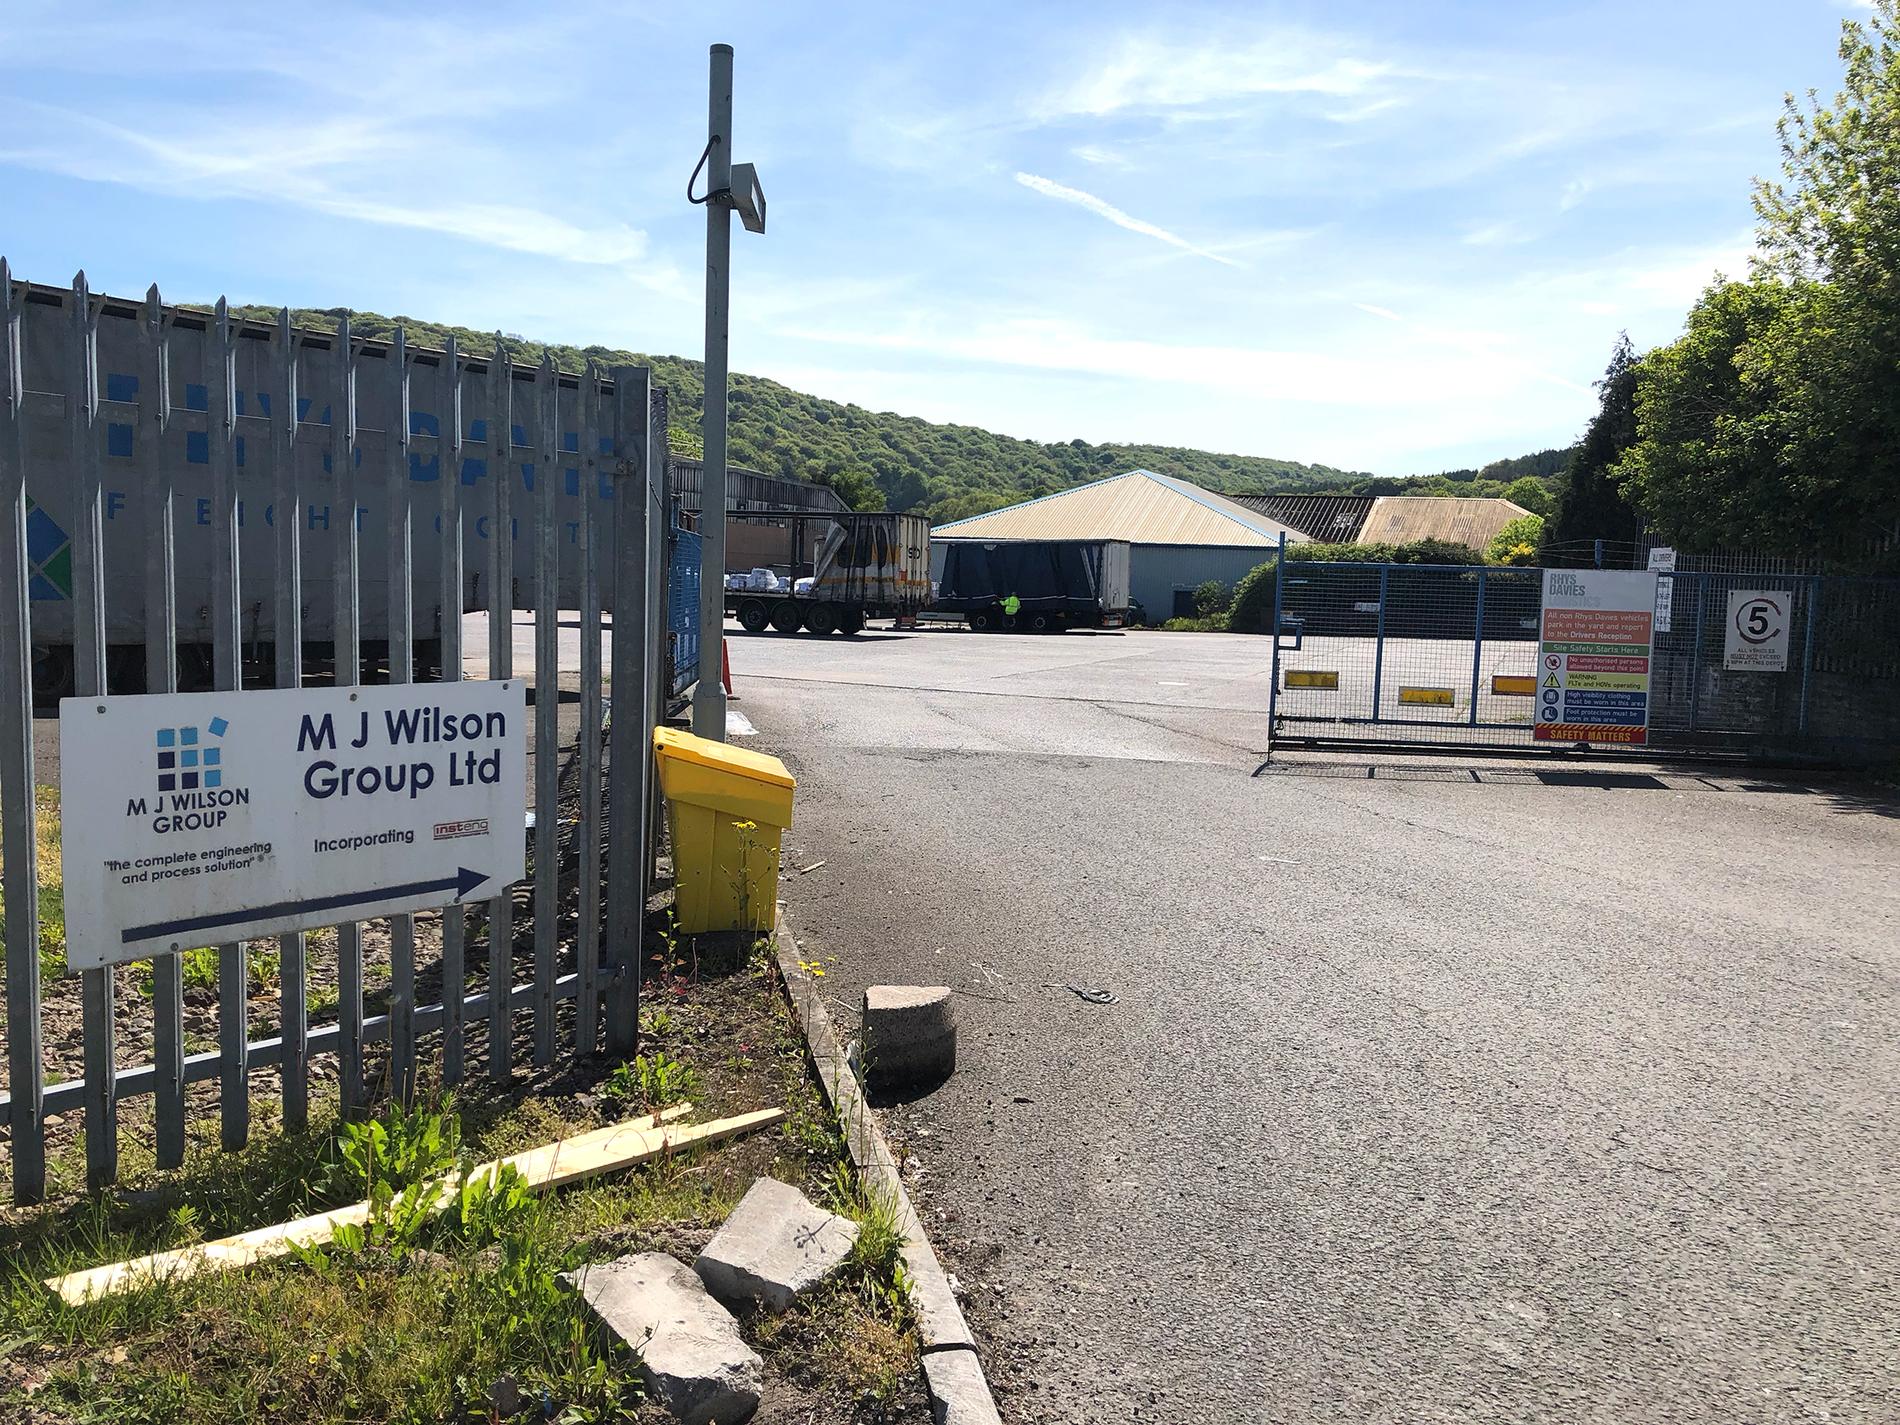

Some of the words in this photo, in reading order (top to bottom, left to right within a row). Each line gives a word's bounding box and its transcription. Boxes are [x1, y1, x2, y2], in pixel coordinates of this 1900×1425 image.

[1550, 573, 1577, 584] RHYS
[1549, 585, 1586, 596] DAVIES
[1575, 613, 1592, 621] Rhys
[1747, 607, 1769, 635] 5
[1548, 621, 1563, 629] park
[1588, 623, 1603, 631] yard
[1621, 624, 1643, 633] report
[1570, 631, 1595, 639] Drivers
[1598, 632, 1632, 641] Reception
[1553, 644, 1566, 652] Site
[1570, 645, 1593, 654] Safety
[1596, 646, 1618, 655] Starts
[1621, 647, 1639, 655] Here
[1567, 691, 1581, 699] High
[1607, 693, 1631, 701] clothing
[297, 713, 337, 751] M
[351, 711, 368, 749] J
[384, 706, 506, 745] Wilson
[1550, 730, 1584, 739] SAFETY
[1588, 732, 1631, 742] MATTERS
[304, 760, 435, 799] Group
[449, 748, 501, 787] Ltd
[126, 798, 147, 817] M
[154, 796, 164, 814] J
[171, 788, 250, 812] WILSON
[152, 810, 228, 834] GROUP
[314, 829, 415, 853] Incorporating
[134, 852, 198, 872] complete
[200, 842, 272, 866] engineering
[121, 869, 148, 885] and
[151, 863, 202, 884] process
